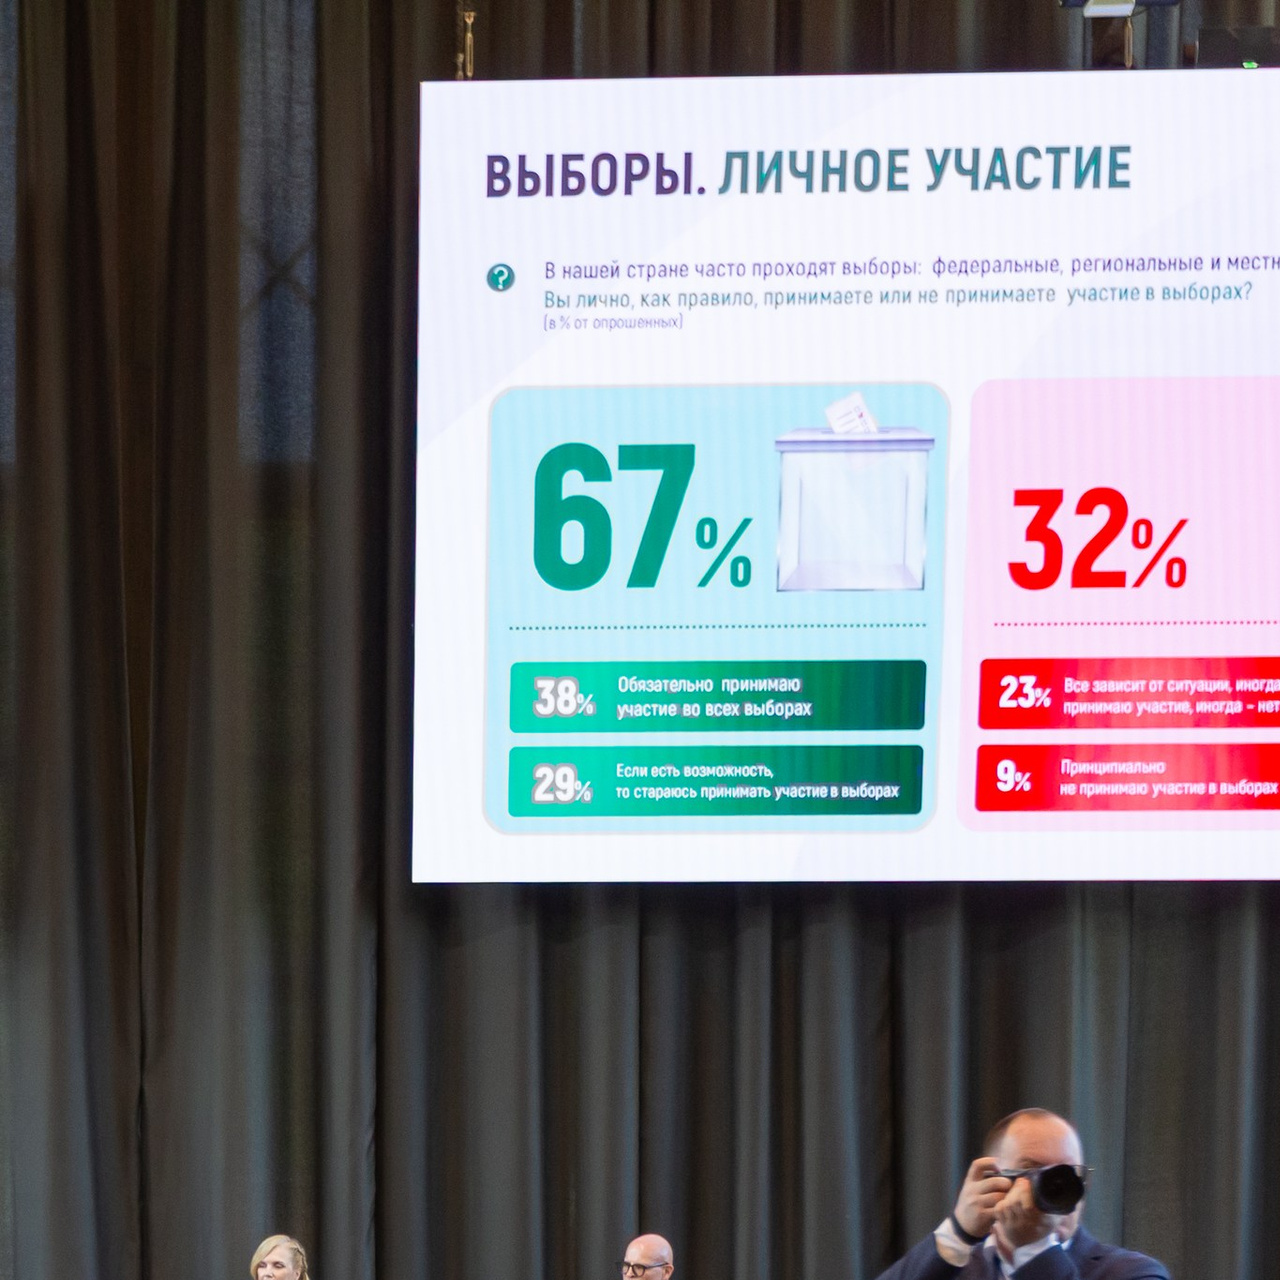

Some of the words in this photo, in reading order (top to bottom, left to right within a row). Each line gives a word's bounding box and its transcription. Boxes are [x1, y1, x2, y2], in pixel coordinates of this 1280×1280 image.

[486, 152, 707, 198] ВЫБОРЫ.
[720, 147, 911, 194] ЛИЧНОЕ
[927, 145, 1131, 192] УЧАСТИЕ
[546, 261, 556, 279] В
[562, 259, 621, 280] нашей
[626, 259, 688, 279] стране
[695, 259, 747, 278] часто
[753, 259, 837, 280] проходят
[842, 257, 922, 278] выборы:
[933, 255, 1063, 277] федеральные,
[1071, 255, 1204, 276] региональные
[1211, 256, 1221, 272] и
[546, 290, 569, 308] Вы
[575, 290, 634, 311] лично,
[640, 290, 672, 308] как
[679, 288, 758, 309] правило,
[764, 288, 873, 308] принимаете
[880, 288, 912, 306] или
[918, 288, 939, 305] не
[946, 286, 1056, 306] принимаете
[1067, 284, 1141, 305] участие
[1146, 286, 1155, 302] в
[1163, 282, 1253, 304] выборах?
[574, 315, 588, 329] от
[532, 441, 753, 592] 67%
[1007, 487, 1188, 590] 32%
[618, 676, 714, 693] Обязательно
[721, 676, 800, 694] принимаю
[999, 676, 1052, 708] 23%
[1064, 677, 1087, 694] Все
[1093, 678, 1146, 694] зависит
[1150, 678, 1163, 693] от
[1167, 677, 1231, 696] ситуации,
[536, 679, 593, 716] 38%
[618, 700, 677, 719] участие
[683, 701, 700, 717] во
[706, 701, 739, 717] всех
[745, 698, 812, 719] выборах
[1064, 698, 1133, 715] принимаю
[1138, 698, 1195, 715] участие,
[1200, 697, 1242, 715] иногда
[616, 763, 646, 779] Если
[651, 764, 679, 779] есть
[684, 762, 773, 780] возможность,
[997, 760, 1032, 792] 9%
[1061, 758, 1166, 777] Принципиально
[535, 767, 591, 801] 29%
[616, 785, 630, 799] то
[634, 785, 696, 801] стараюсь
[700, 785, 771, 801] принимать
[776, 783, 829, 801] участие
[831, 785, 837, 797] в
[842, 782, 899, 800] выборах
[1060, 781, 1075, 795] не
[1079, 781, 1148, 798] принимаю
[1153, 780, 1206, 797] участие
[1210, 781, 1216, 795] в
[1220, 779, 1279, 797] выборах
